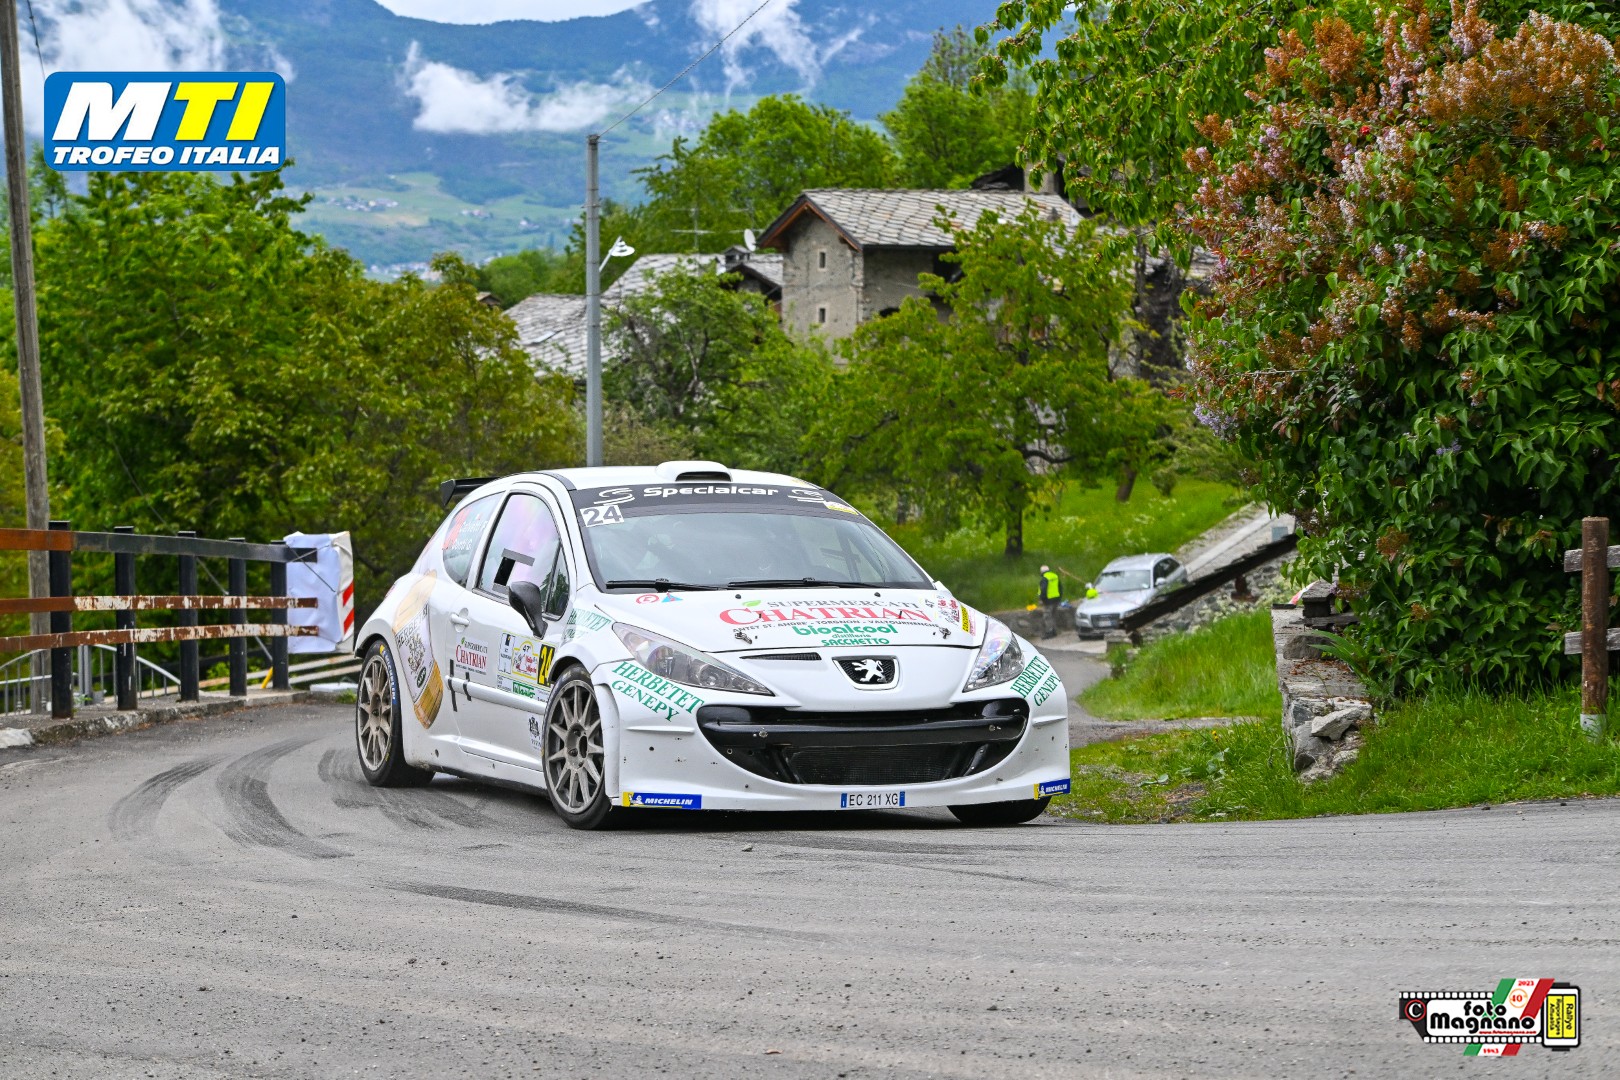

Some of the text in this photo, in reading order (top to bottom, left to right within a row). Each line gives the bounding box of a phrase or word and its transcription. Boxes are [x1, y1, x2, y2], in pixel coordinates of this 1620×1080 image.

[643, 486, 779, 498] Specialcar
[583, 505, 622, 526] 24
[767, 600, 920, 608] SUPERMERCATI
[719, 606, 932, 625] CHATRIAN
[792, 624, 899, 636] bioalcool
[821, 638, 890, 646] SACCHETTO
[1010, 655, 1050, 698] HERBETET
[612, 661, 705, 714] HERBETET
[1033, 673, 1061, 707] GENEPY
[611, 680, 679, 722] GENEPY
[645, 798, 693, 806] MICHELIN
[849, 794, 863, 806] EC
[867, 794, 882, 806] 211
[885, 792, 899, 806] XG
